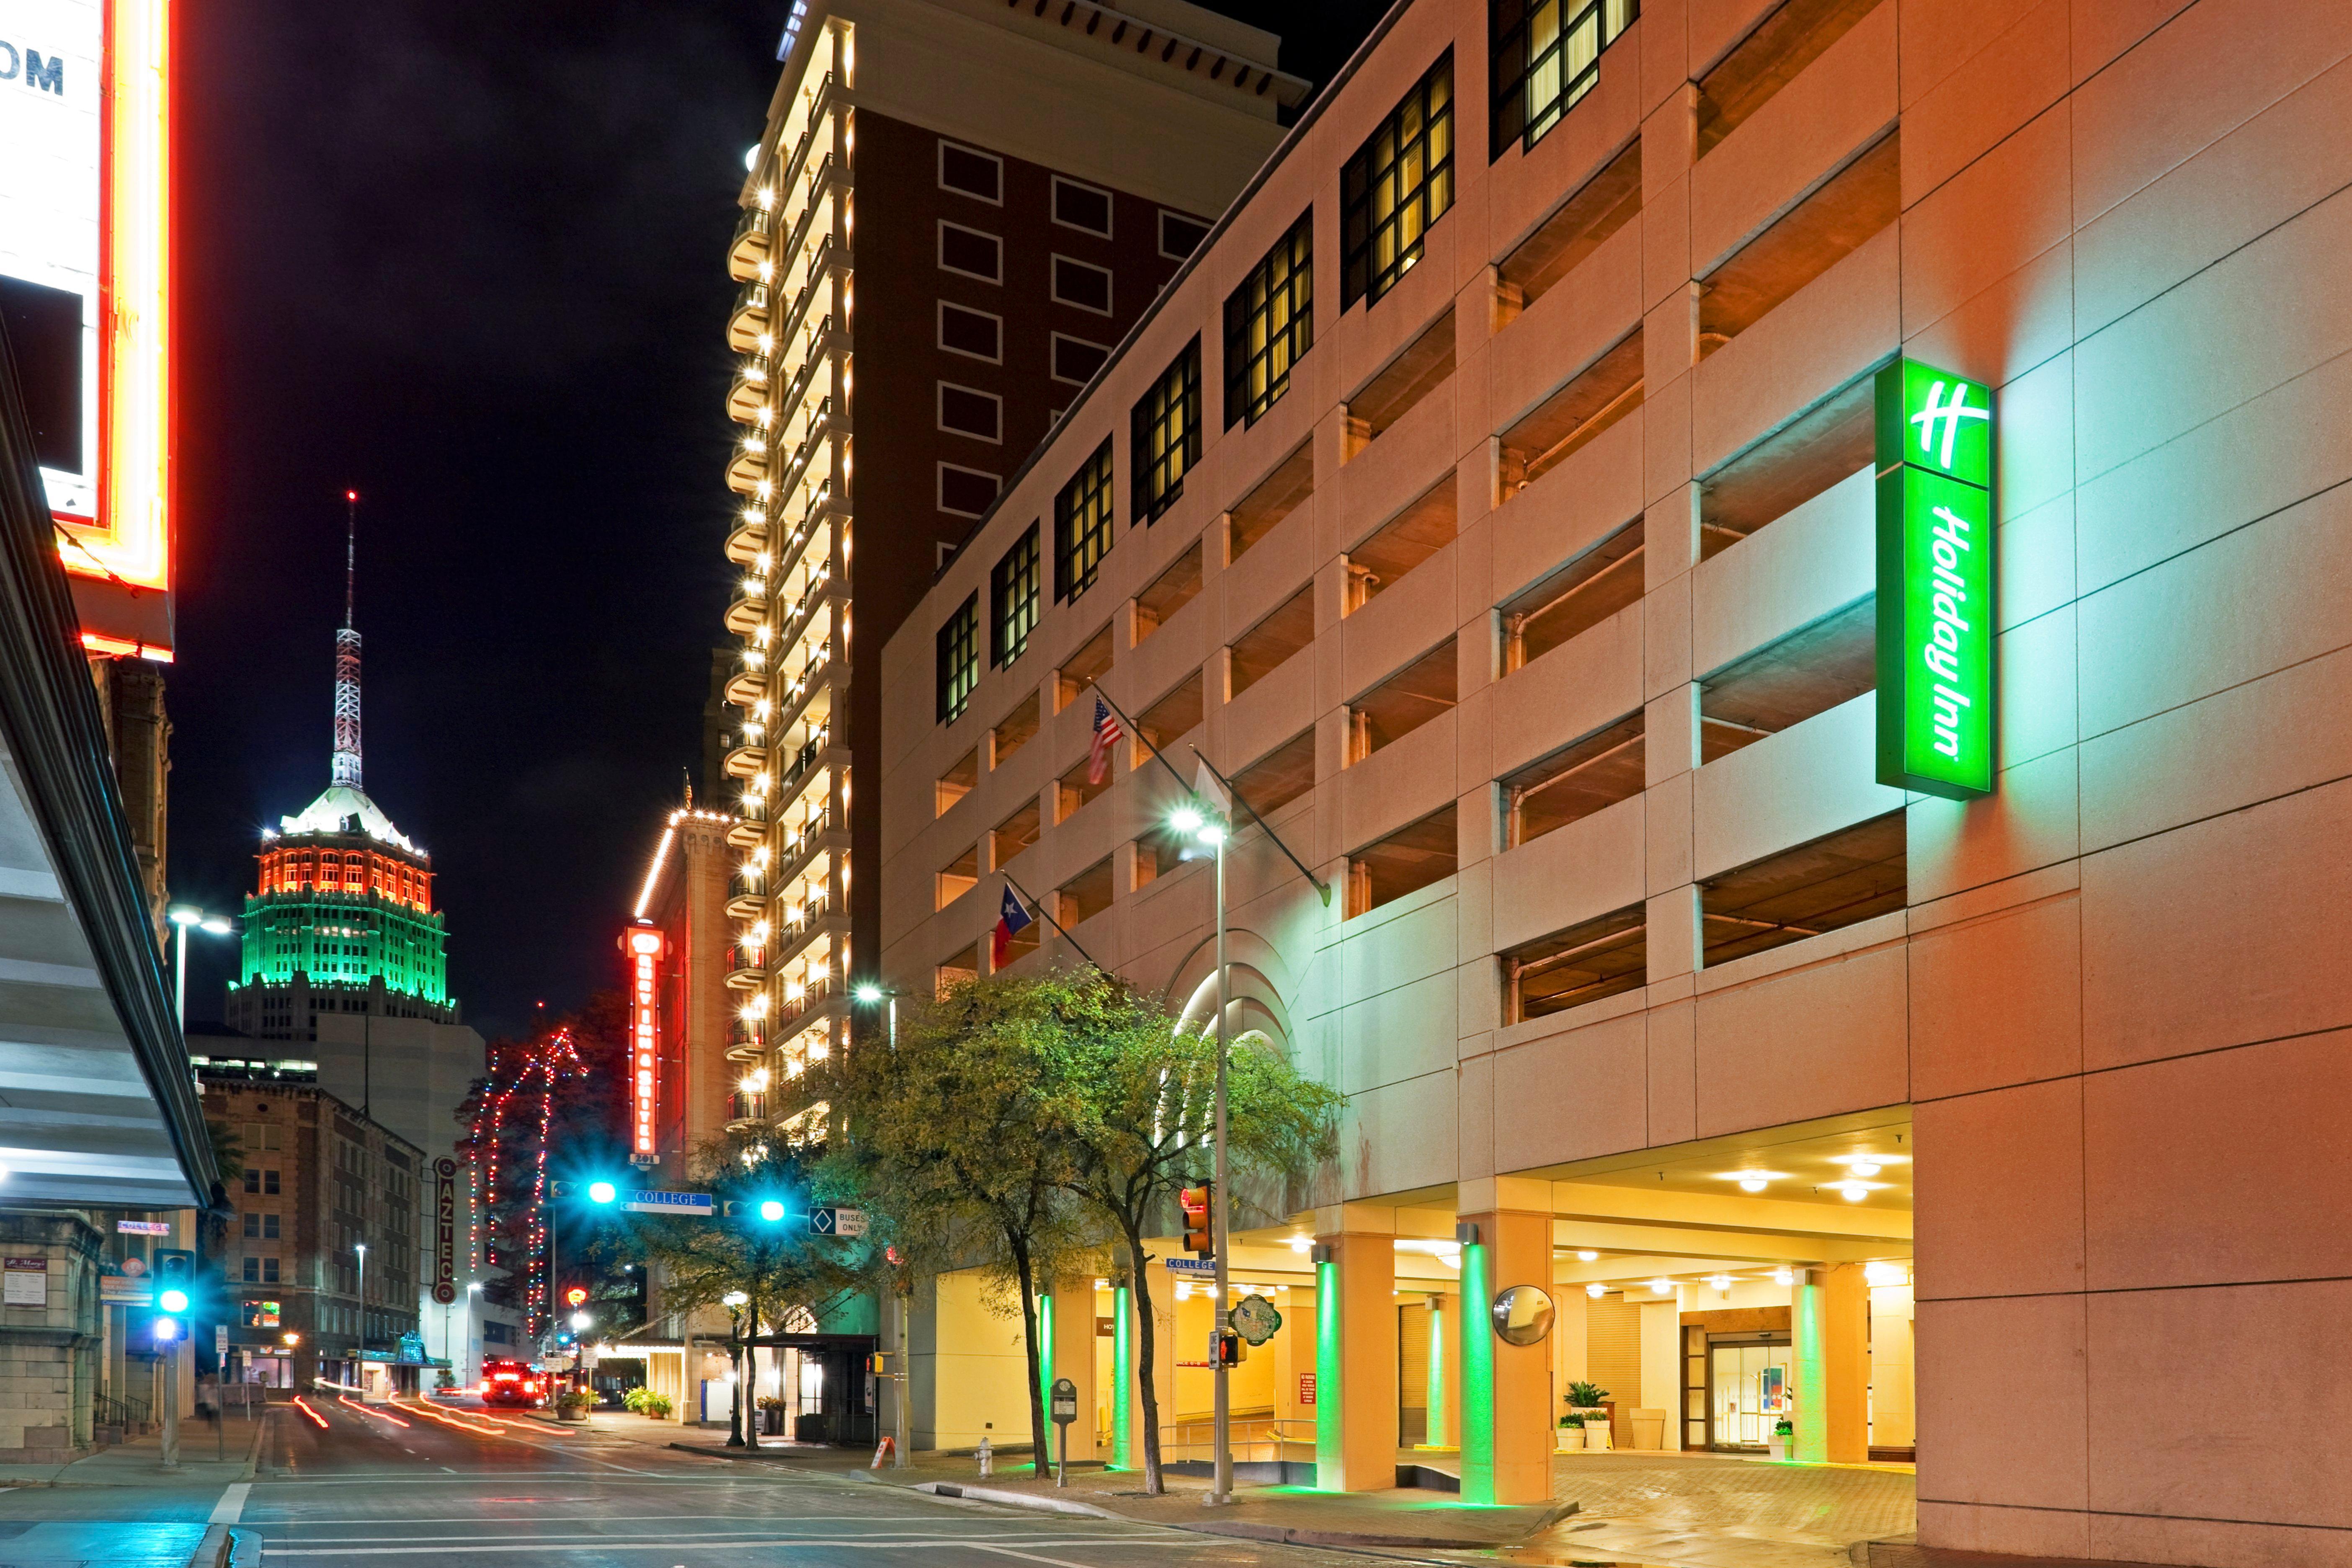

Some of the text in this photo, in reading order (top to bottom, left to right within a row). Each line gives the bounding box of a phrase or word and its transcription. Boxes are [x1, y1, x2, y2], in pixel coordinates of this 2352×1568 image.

[1924, 506, 1970, 756] Holiday Inn
[635, 1155, 654, 1163] 201
[635, 1191, 697, 1205] COLLEGE
[840, 1214, 865, 1222] BUSES
[121, 1222, 167, 1230] COLLEGE
[441, 1183, 453, 1279] AZTEC
[1169, 1259, 1213, 1269] COLLEGE
